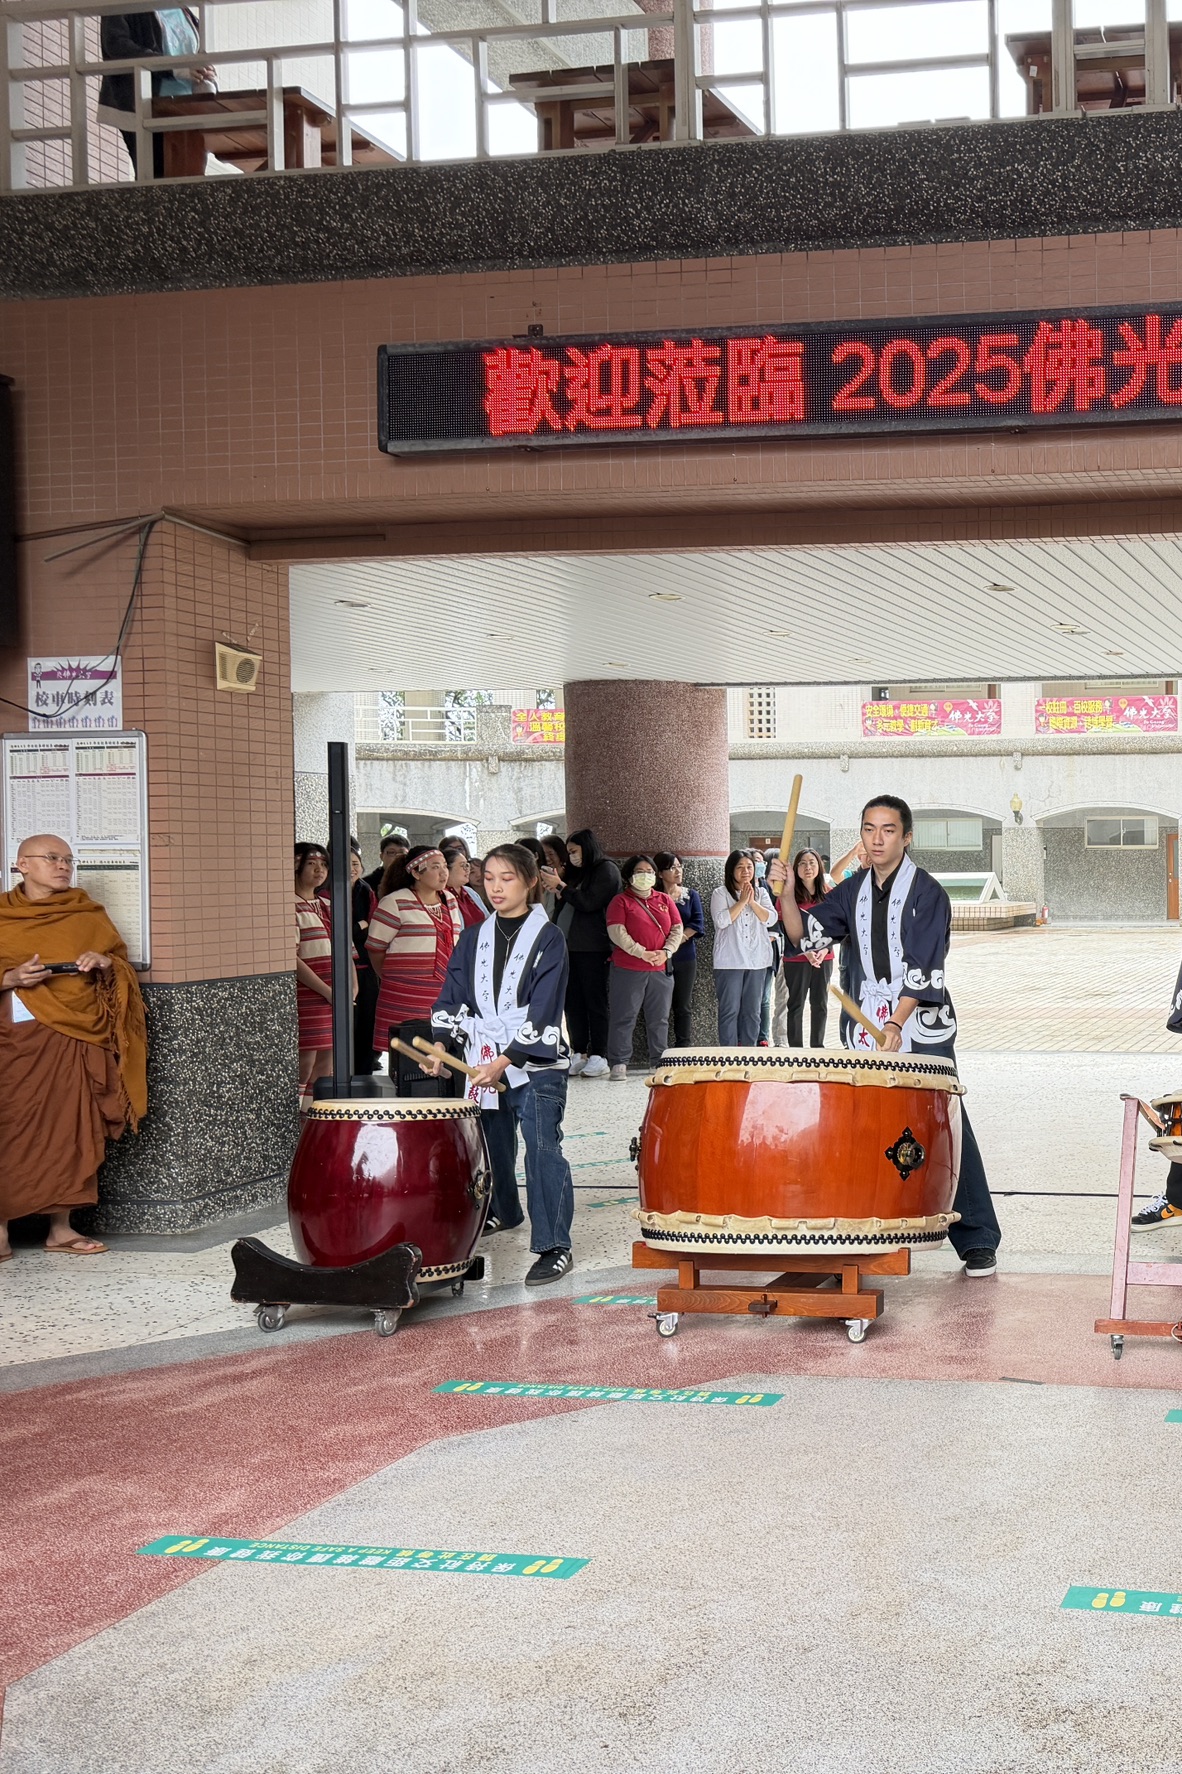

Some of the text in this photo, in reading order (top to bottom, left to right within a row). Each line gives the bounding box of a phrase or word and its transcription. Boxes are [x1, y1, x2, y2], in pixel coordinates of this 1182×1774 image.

[483, 335, 805, 436] 歡迎蒞臨
[35, 690, 114, 707] 校車時刻表
[876, 1004, 890, 1024] 佛
[248, 1542, 310, 1551] DISTANCE
[310, 1545, 345, 1553] SAFE
[356, 1547, 392, 1555] KEEP
[203, 1546, 517, 1573] 保持社交距離維護你我健康
